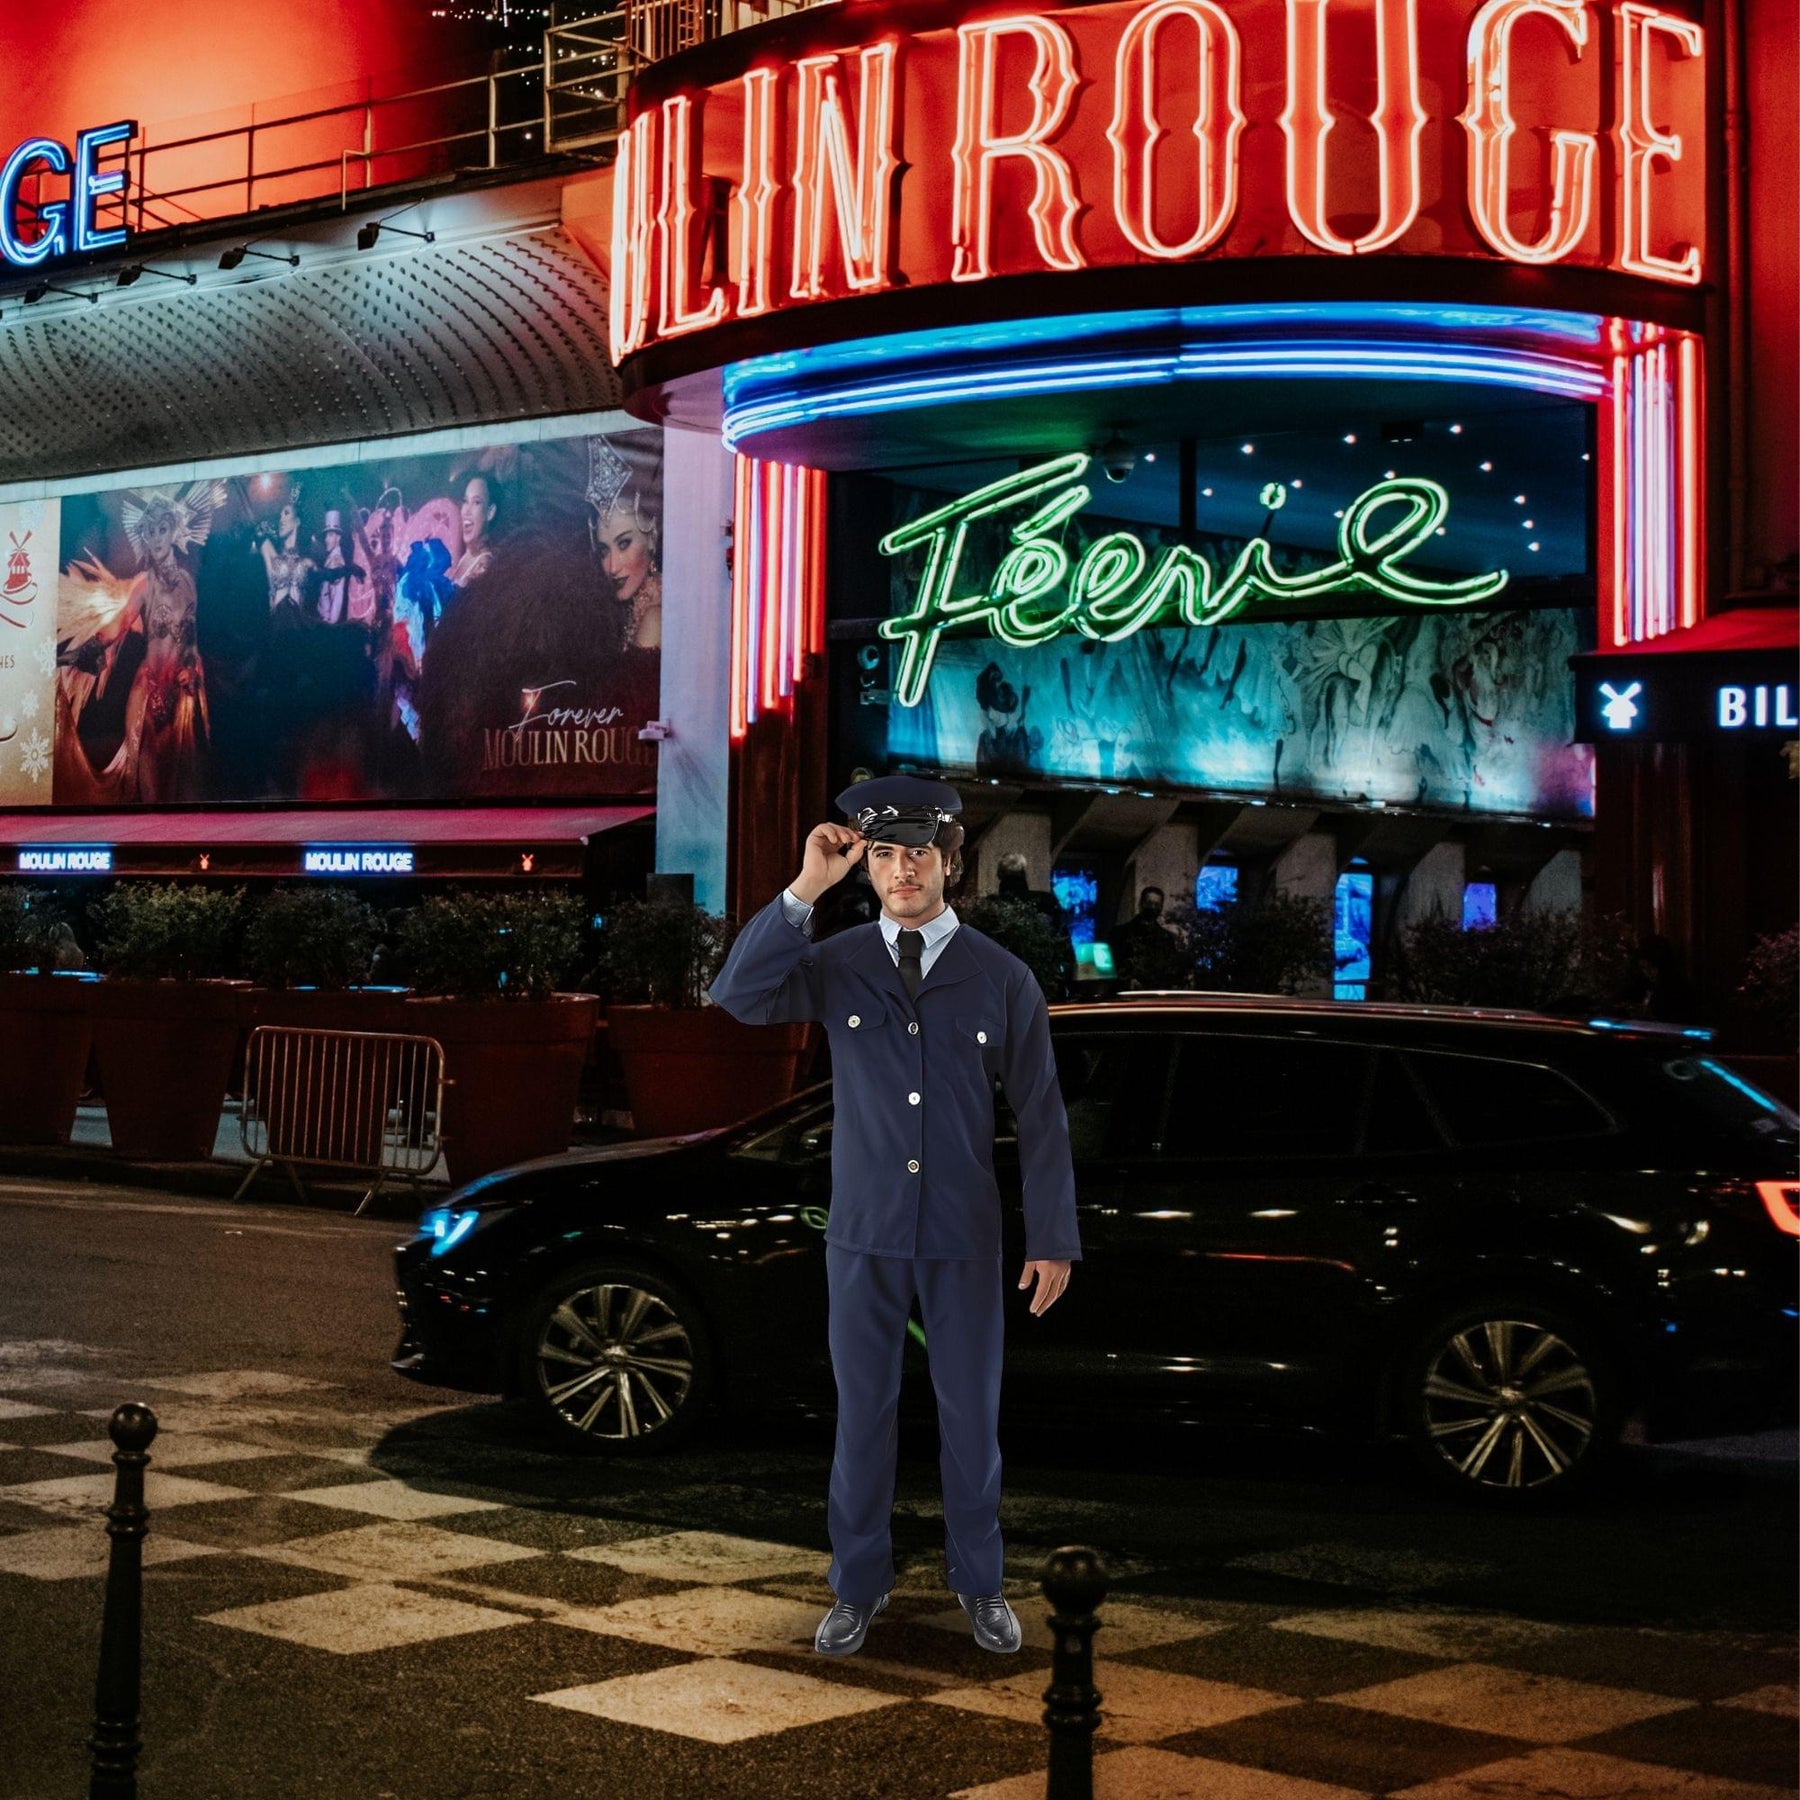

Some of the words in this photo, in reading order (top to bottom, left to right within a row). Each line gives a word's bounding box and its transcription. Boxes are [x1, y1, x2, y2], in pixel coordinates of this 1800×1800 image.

[951, 0, 1705, 285] ROUGE
[0, 120, 137, 265] GE
[878, 452, 1509, 709] Féerie
[508, 679, 624, 743] Forever
[1718, 685, 1799, 727] BIL
[483, 728, 569, 770] MOULIN
[19, 852, 67, 870] MOULIN
[67, 852, 111, 870] ROUGE
[305, 852, 360, 871] MOULIN
[362, 853, 414, 872] ROUGE
